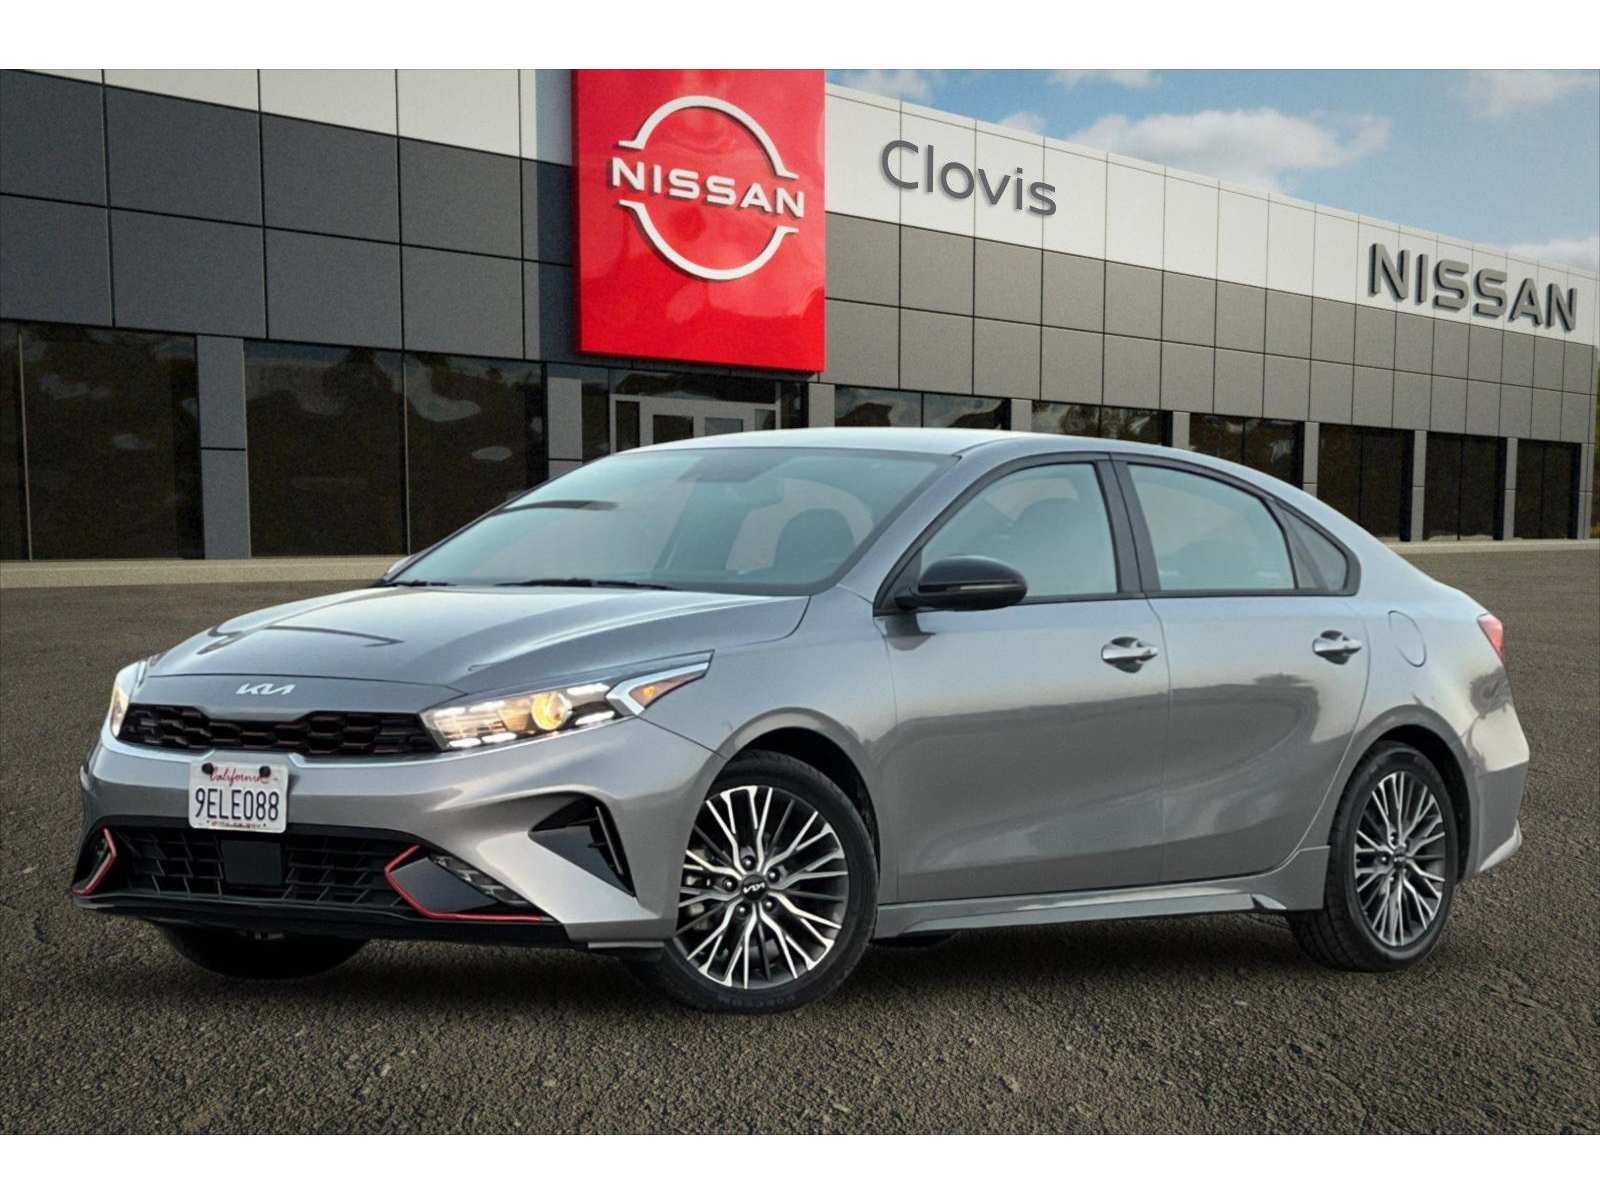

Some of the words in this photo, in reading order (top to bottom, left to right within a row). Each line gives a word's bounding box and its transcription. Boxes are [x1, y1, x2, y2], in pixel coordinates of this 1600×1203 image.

[610, 156, 805, 219] NISSAN
[880, 140, 1057, 216] Clovis
[1368, 242, 1578, 332] NISSAN
[194, 787, 280, 821] 9ELE088
